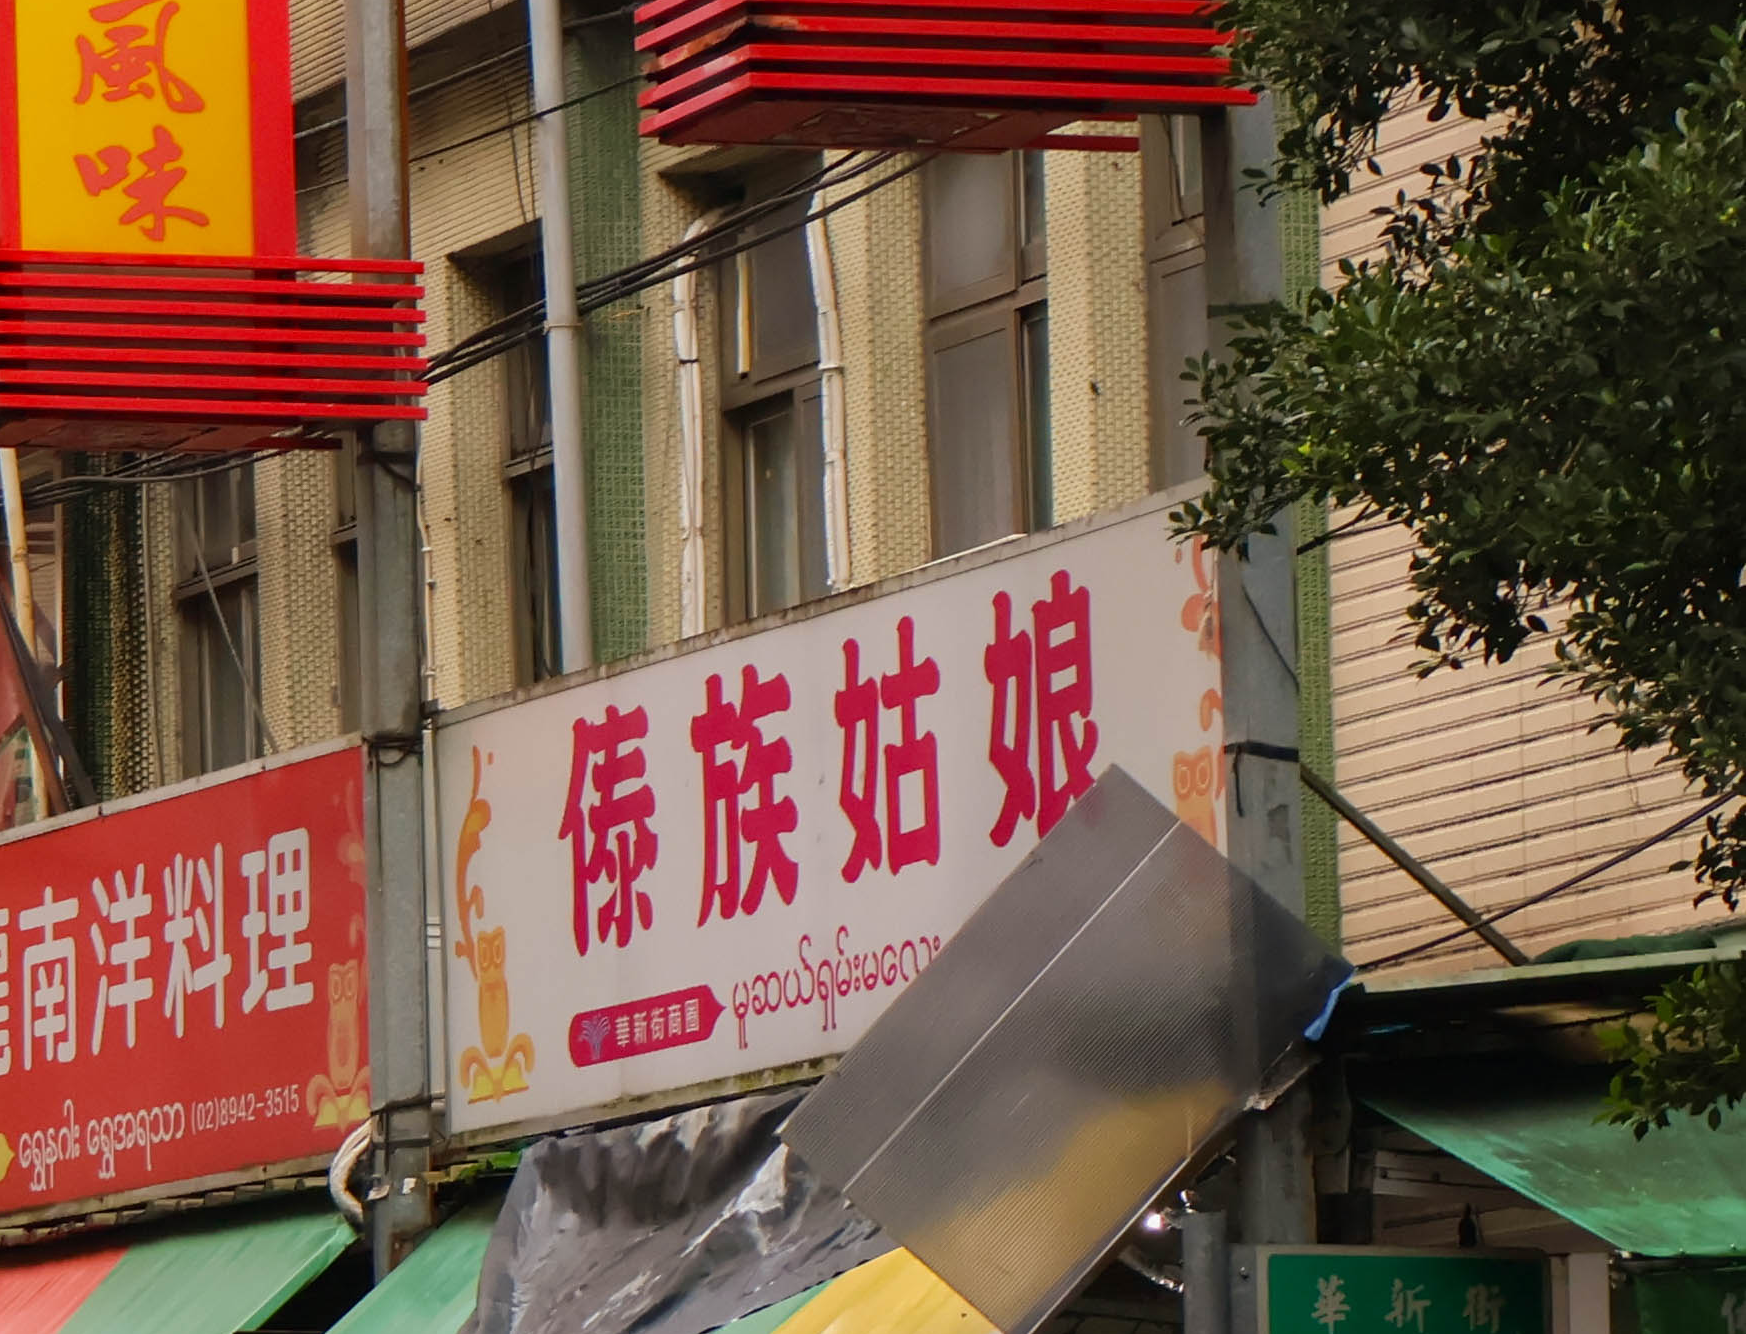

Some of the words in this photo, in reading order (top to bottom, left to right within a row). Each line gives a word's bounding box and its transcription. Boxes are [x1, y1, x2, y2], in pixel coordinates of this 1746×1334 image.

[557, 568, 1099, 956] 傣族姑娘
[190, 1083, 300, 1137] (02)8942-3515
